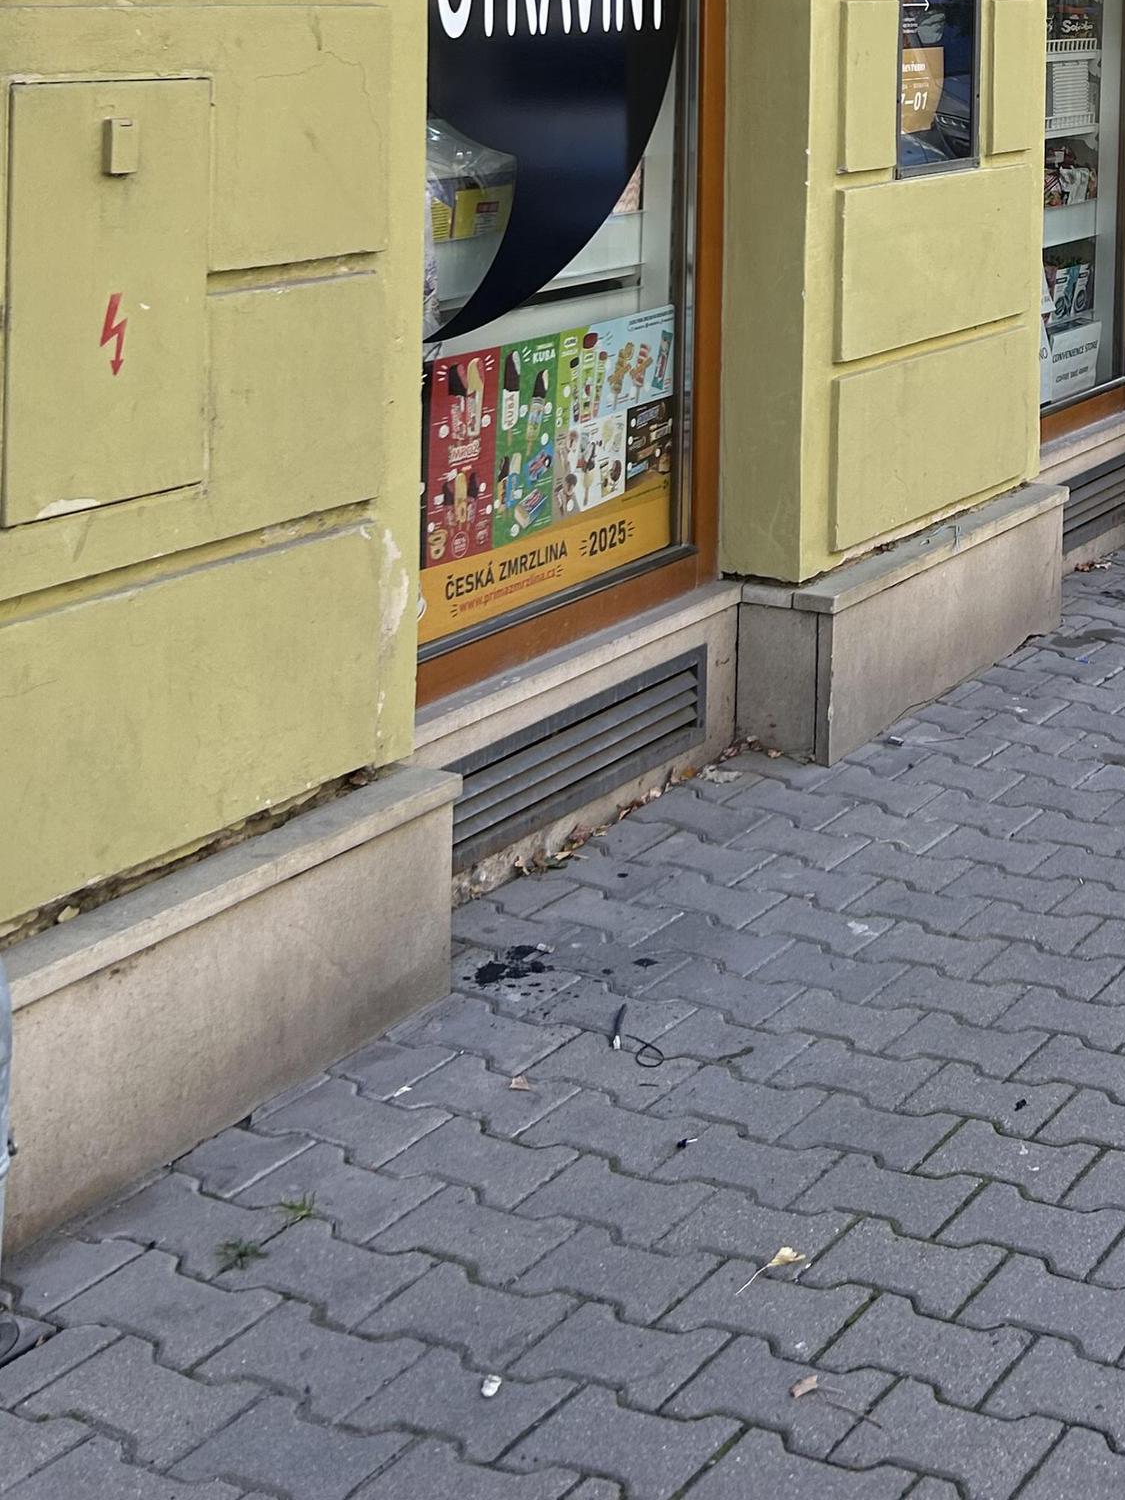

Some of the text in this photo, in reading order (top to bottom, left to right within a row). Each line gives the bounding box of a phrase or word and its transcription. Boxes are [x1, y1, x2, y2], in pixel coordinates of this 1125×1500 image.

[589, 519, 627, 557] 2025
[445, 560, 495, 601] ČESKÁ
[499, 539, 568, 582] ZMRZLINA
